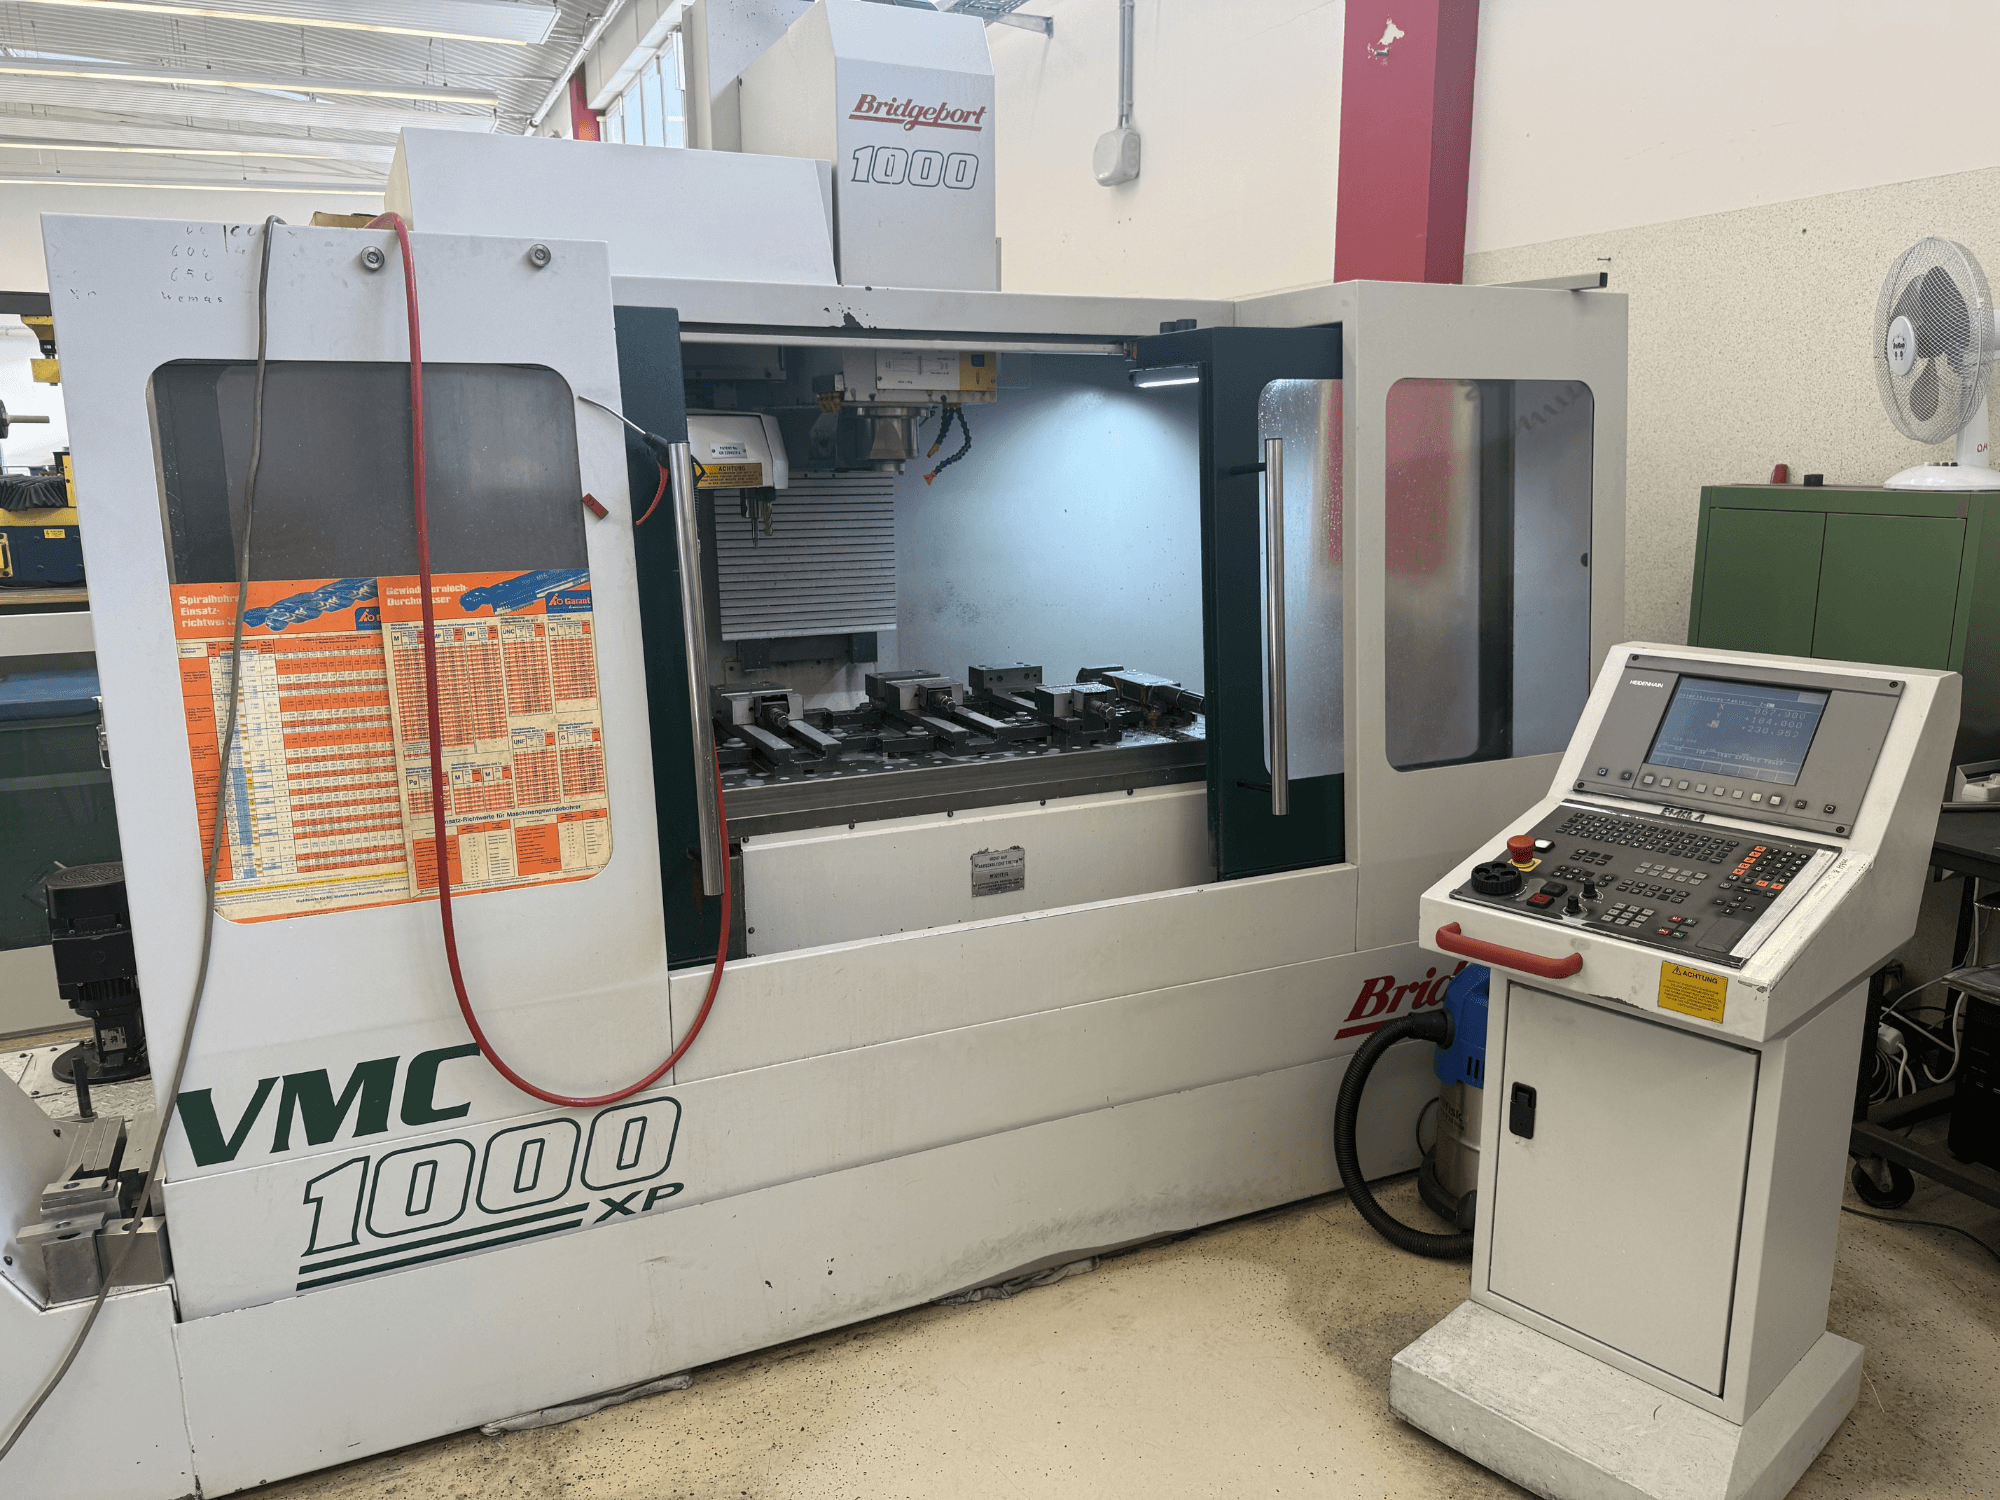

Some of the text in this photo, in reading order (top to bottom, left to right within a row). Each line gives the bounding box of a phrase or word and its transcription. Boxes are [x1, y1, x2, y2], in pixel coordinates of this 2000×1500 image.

[850, 93, 987, 131] Bridgeport
[851, 145, 979, 190] 1000
[178, 594, 240, 606] Spiralbohre
[386, 583, 469, 596] Gewindernloch-
[387, 596, 451, 607] Durchmsser
[564, 597, 591, 605] Garant
[180, 606, 220, 616] Einsatz-
[1683, 970, 1718, 985] ACHTUNG
[1343, 961, 1467, 1022] Brid
[176, 1042, 480, 1167] VMC
[301, 1096, 682, 1257] 1000
[593, 1182, 685, 1225] XP
